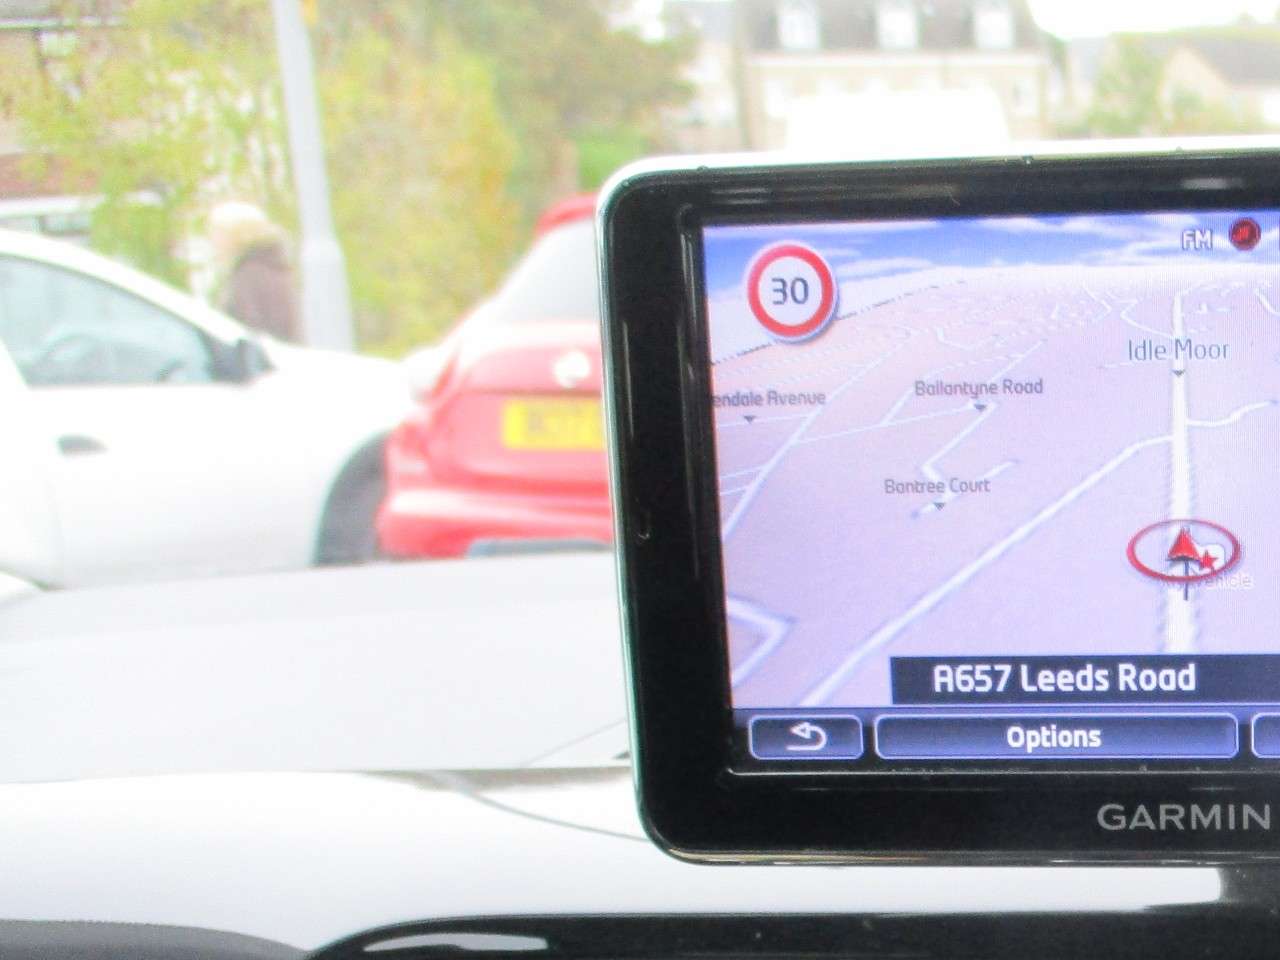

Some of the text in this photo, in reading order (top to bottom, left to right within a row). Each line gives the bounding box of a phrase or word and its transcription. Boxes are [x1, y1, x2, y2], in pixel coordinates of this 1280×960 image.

[1182, 229, 1213, 250] FM
[771, 277, 810, 306] 30
[1127, 338, 1229, 362] Idle Moor
[766, 389, 827, 406] Avenue
[914, 378, 1044, 399] Ballantyne Road
[949, 477, 992, 493] Court
[933, 662, 1197, 693] A657 Leeds Road
[1006, 725, 1102, 754] Options
[1096, 803, 1272, 832] GARMIN
